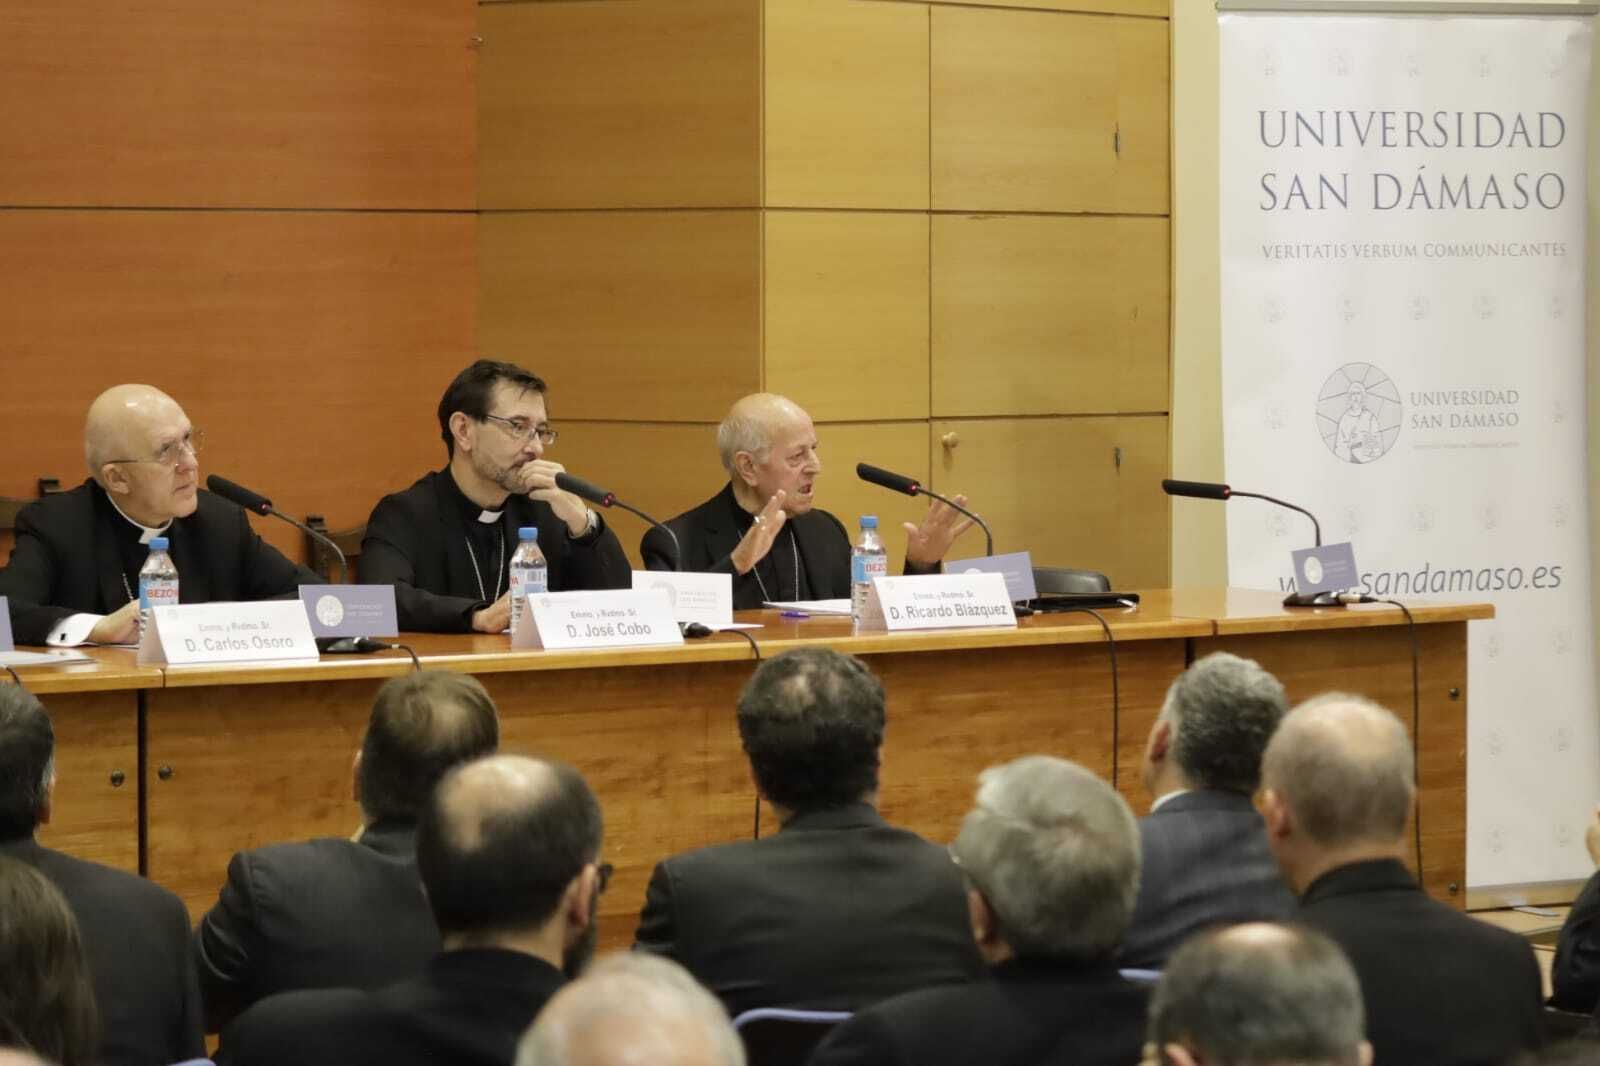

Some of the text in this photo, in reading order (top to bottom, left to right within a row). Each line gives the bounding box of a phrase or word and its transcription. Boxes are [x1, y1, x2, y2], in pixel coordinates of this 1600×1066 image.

[1258, 110, 1566, 149] UNIVERSIDAD
[1259, 165, 1566, 211] SAN DÁMASO
[1262, 242, 1567, 259] VERITATIS VERBUM COMMUNICANTES
[1410, 390, 1520, 406] UNIVERSIDAD
[1411, 414, 1443, 429] SAN
[889, 602, 1008, 620] D. Ricardo Blázquez
[566, 622, 652, 638] D. José Cobo
[184, 635, 295, 652] D. Carlos Osoro
